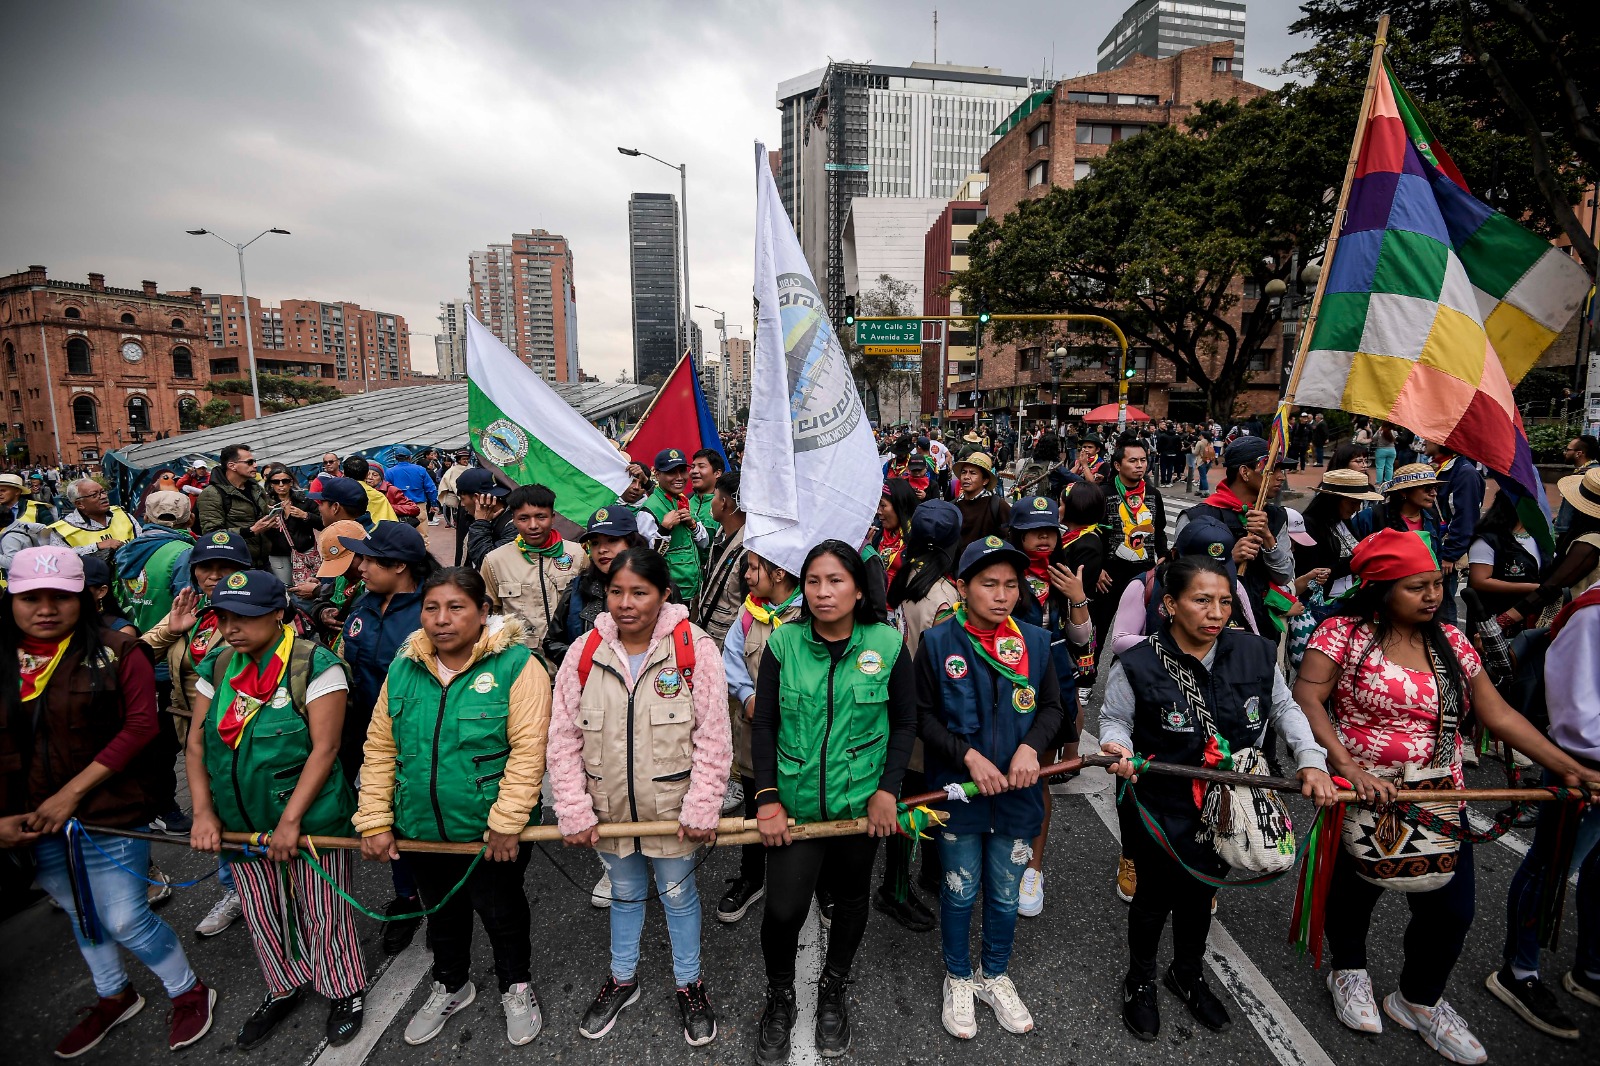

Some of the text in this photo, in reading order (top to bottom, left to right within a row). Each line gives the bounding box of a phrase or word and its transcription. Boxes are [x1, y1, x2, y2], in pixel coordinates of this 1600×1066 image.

[870, 322, 918, 330] Av Calle 53
[870, 333, 915, 341] Avenida 32
[34, 553, 59, 574] NY
